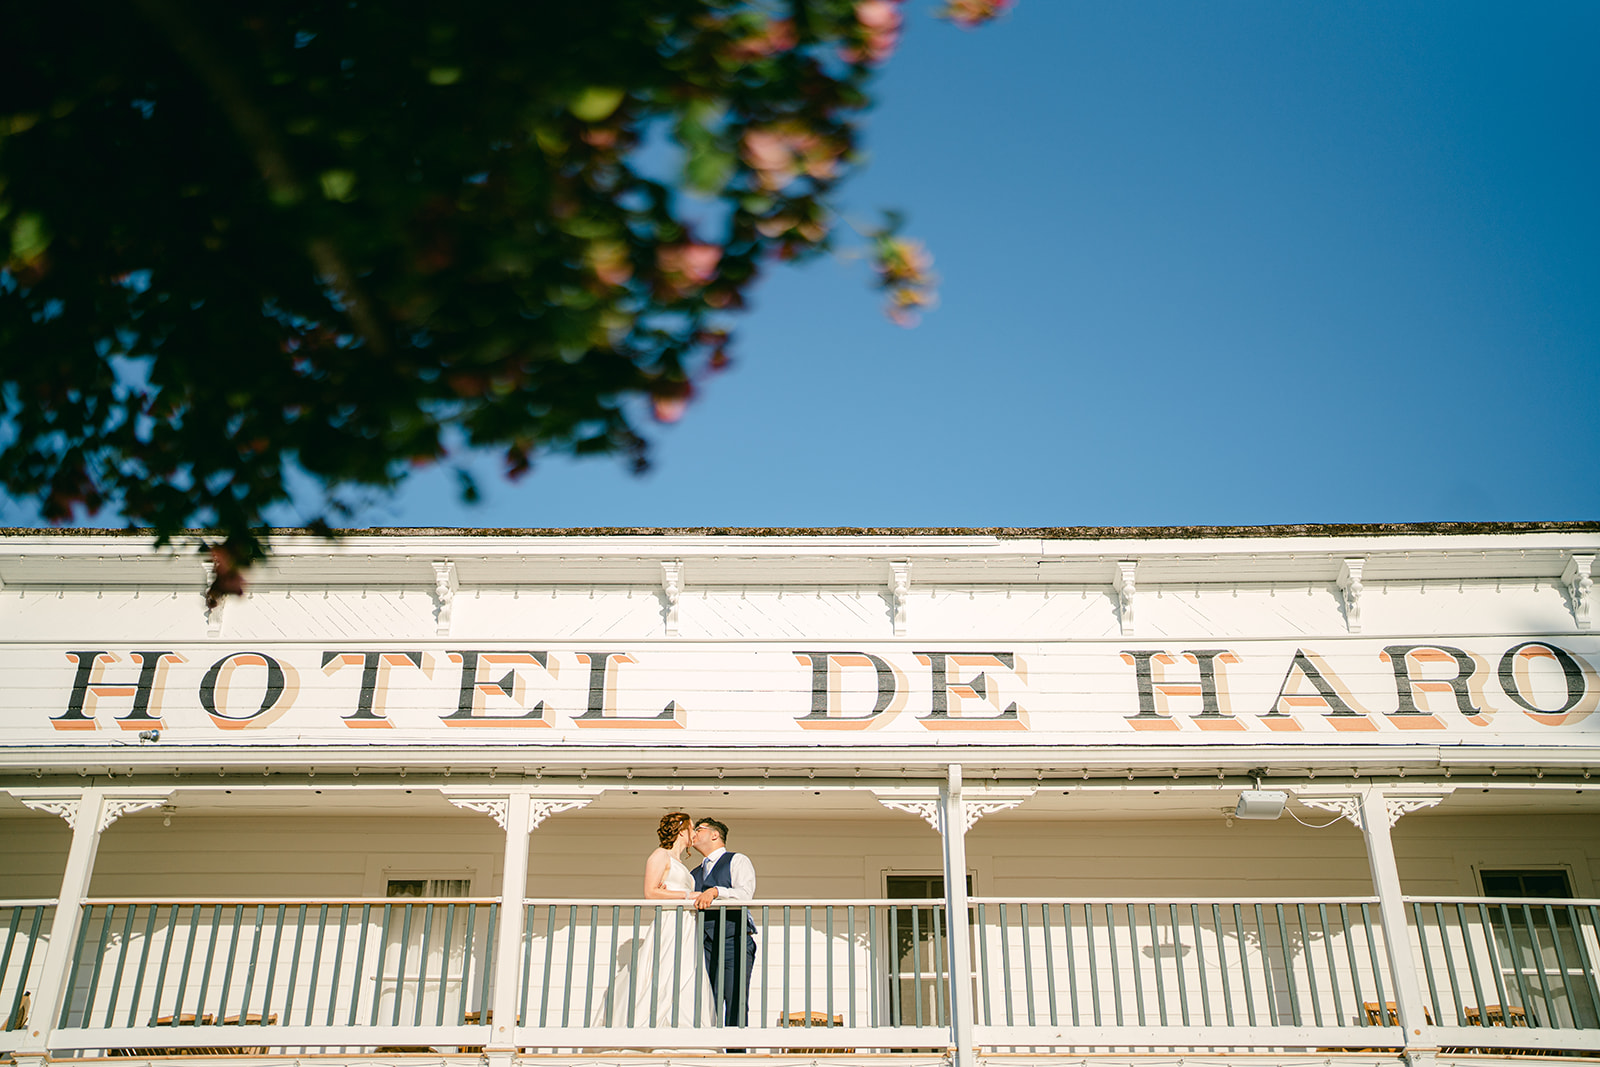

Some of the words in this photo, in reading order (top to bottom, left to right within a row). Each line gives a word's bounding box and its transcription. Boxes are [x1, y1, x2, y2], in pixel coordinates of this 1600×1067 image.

[49, 651, 687, 730] HOTEL
[792, 650, 1030, 732] DE
[1120, 641, 1600, 732] HARO
